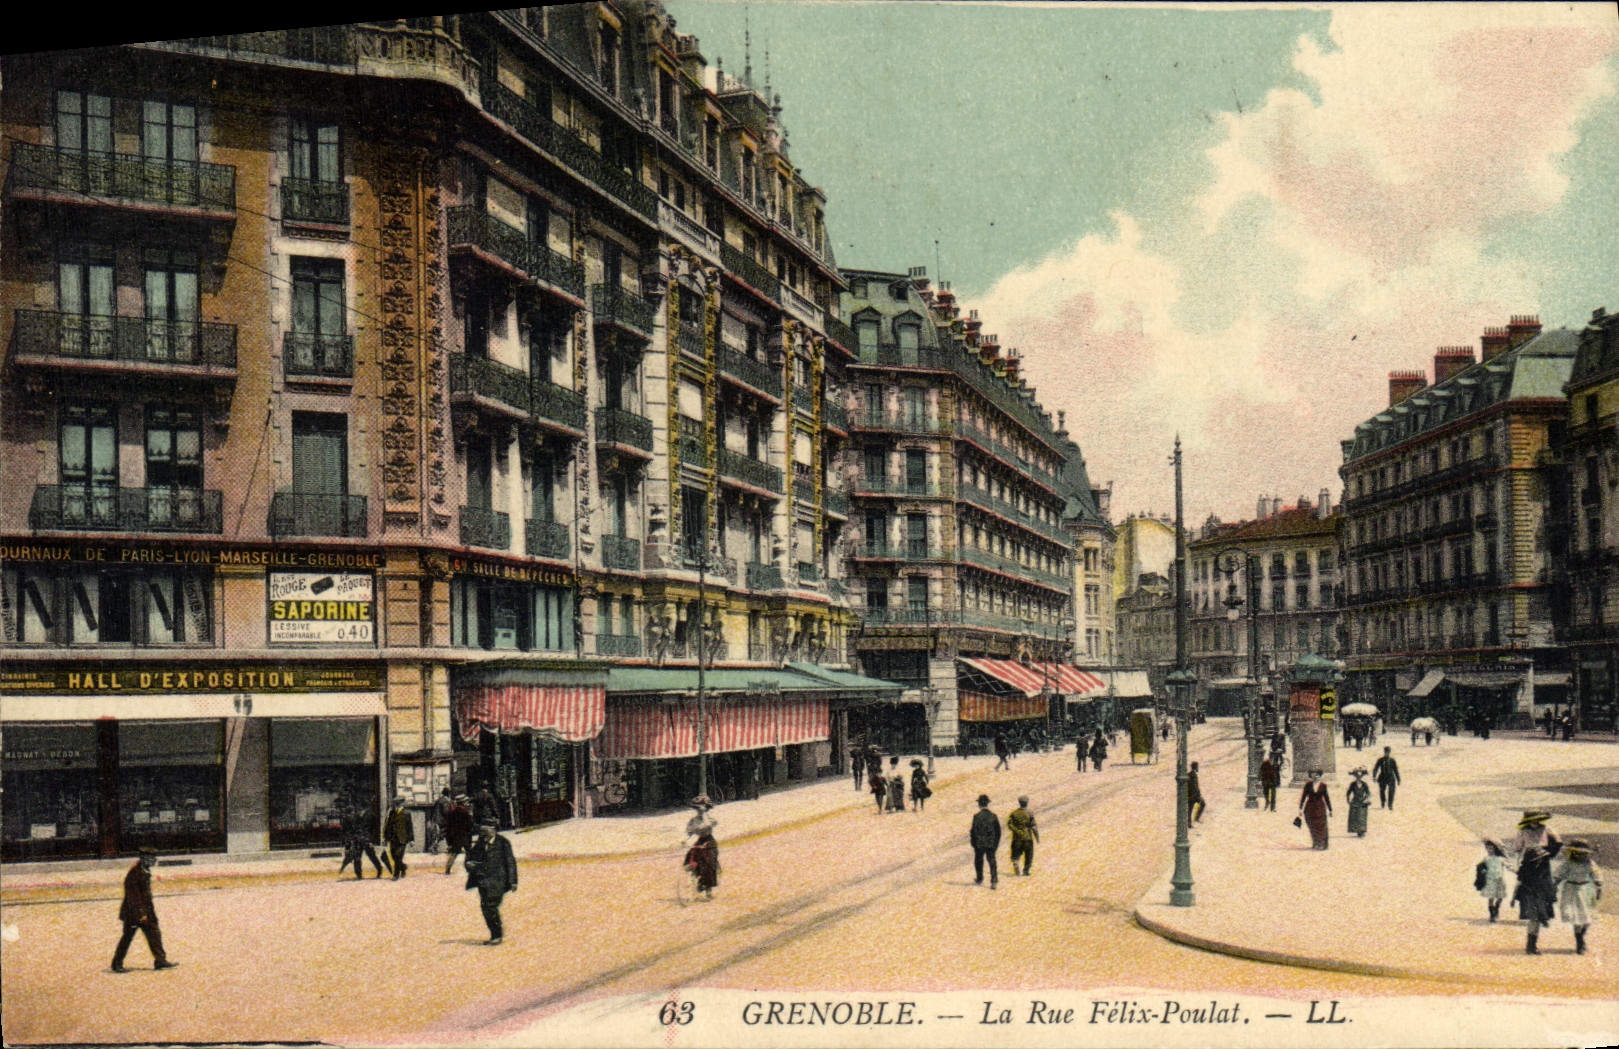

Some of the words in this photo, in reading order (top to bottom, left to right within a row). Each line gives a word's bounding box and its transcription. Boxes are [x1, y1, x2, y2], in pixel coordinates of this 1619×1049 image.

[86, 548, 105, 561] DE
[473, 562, 500, 577] SALLE
[271, 578, 307, 599] ROUGE
[273, 601, 370, 620] SAPORINE
[274, 623, 310, 631] LESSIVE
[68, 672, 122, 689] HALL
[140, 671, 294, 688] D'EXPOSITION
